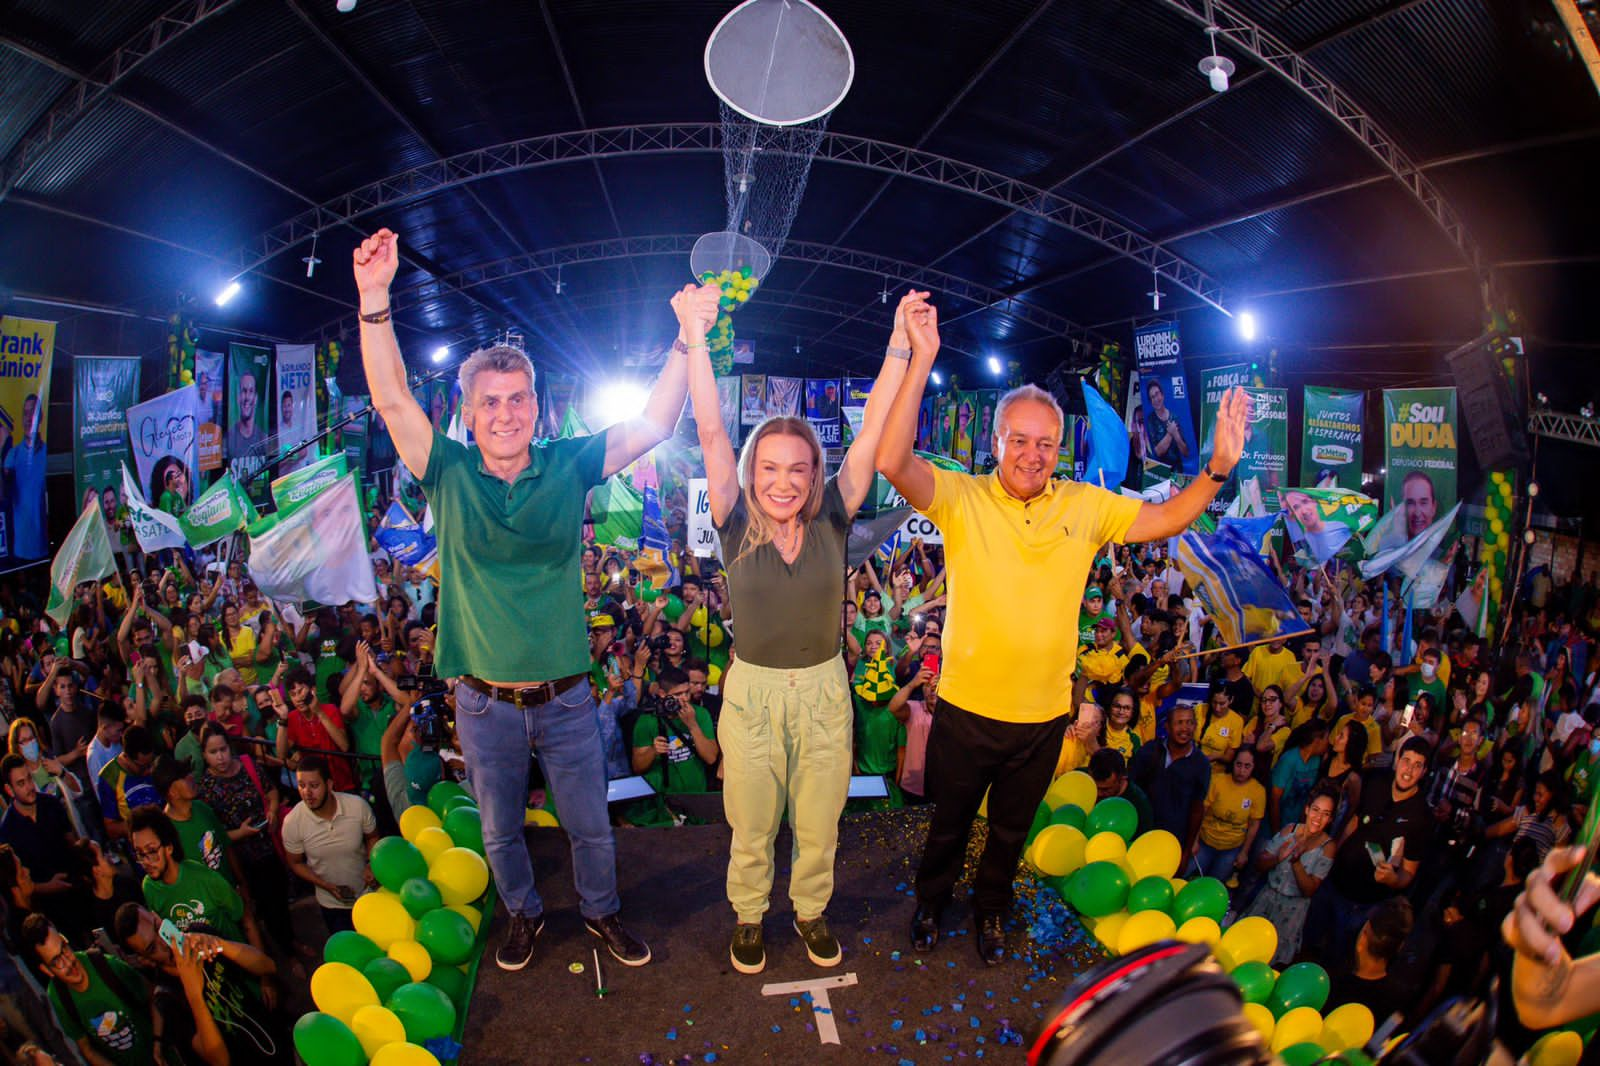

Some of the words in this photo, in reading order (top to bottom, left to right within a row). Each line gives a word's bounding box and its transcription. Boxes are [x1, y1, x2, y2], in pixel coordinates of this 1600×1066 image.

[0, 331, 44, 355] rank
[1138, 342, 1180, 359] PINHEIRO
[0, 355, 42, 378] únior
[280, 371, 310, 389] NETO
[1212, 373, 1239, 388] FORÇA
[1206, 390, 1223, 404] TRA
[1256, 409, 1287, 419] PESSOAS
[811, 424, 840, 435] UTE
[1314, 429, 1361, 443] ESPERANÇA
[1391, 423, 1456, 449] DUDA
[1391, 458, 1424, 468] DEPUTADO
[695, 490, 709, 514] IG
[1207, 498, 1232, 512] Hele
[907, 518, 940, 535] CO
